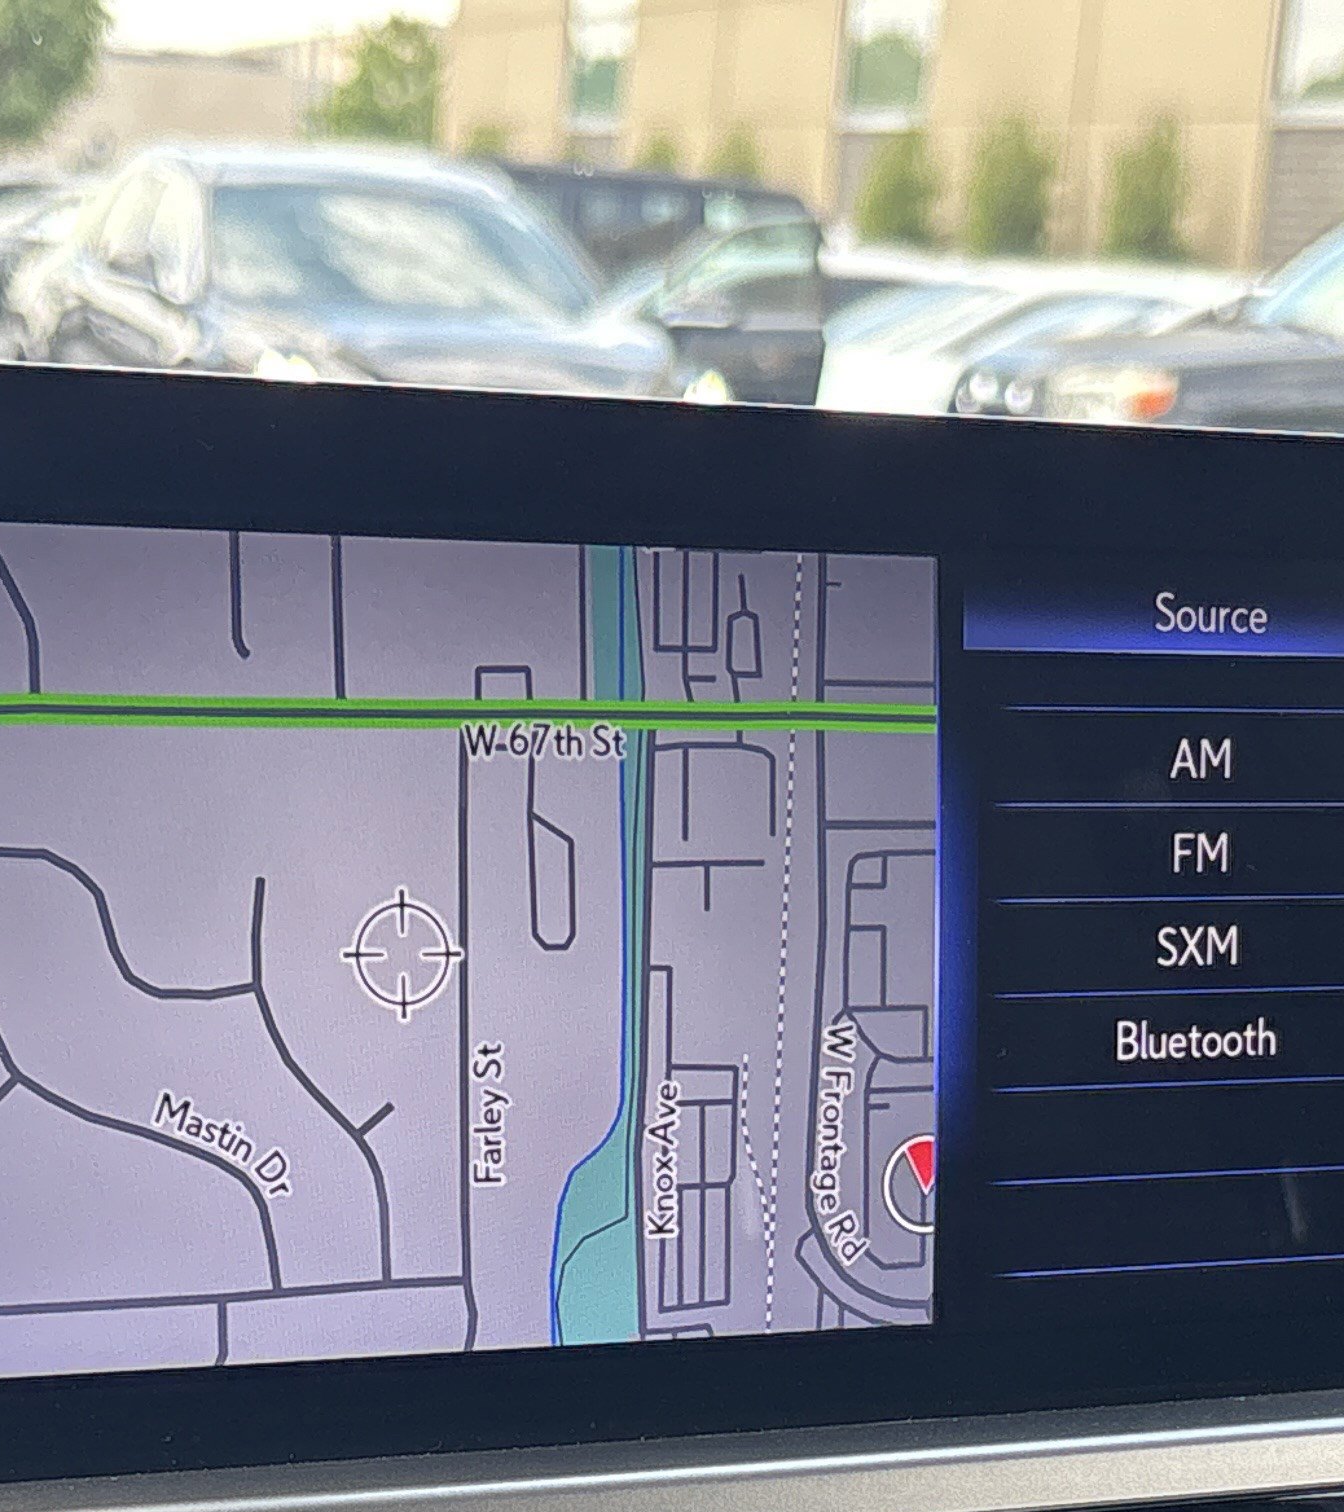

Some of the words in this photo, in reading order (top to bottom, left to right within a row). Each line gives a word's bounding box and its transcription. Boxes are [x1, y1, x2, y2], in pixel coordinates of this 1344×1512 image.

[1155, 591, 1269, 635] Source
[464, 725, 498, 754] W
[508, 724, 584, 757] 67th
[591, 725, 626, 756] St
[1169, 737, 1232, 780] AM
[1172, 831, 1229, 874] FM
[1156, 924, 1239, 967] SXM
[473, 1041, 504, 1080] St
[824, 1022, 857, 1058] W
[1115, 1017, 1277, 1062] Bluetooth
[473, 1088, 510, 1186] Farley
[648, 1082, 679, 1150] Ave
[155, 1093, 254, 1163] Mastin
[253, 1150, 291, 1198] Dr
[810, 1070, 853, 1214] Frontage
[648, 1156, 678, 1238] Knox
[826, 1211, 867, 1266] Rd
